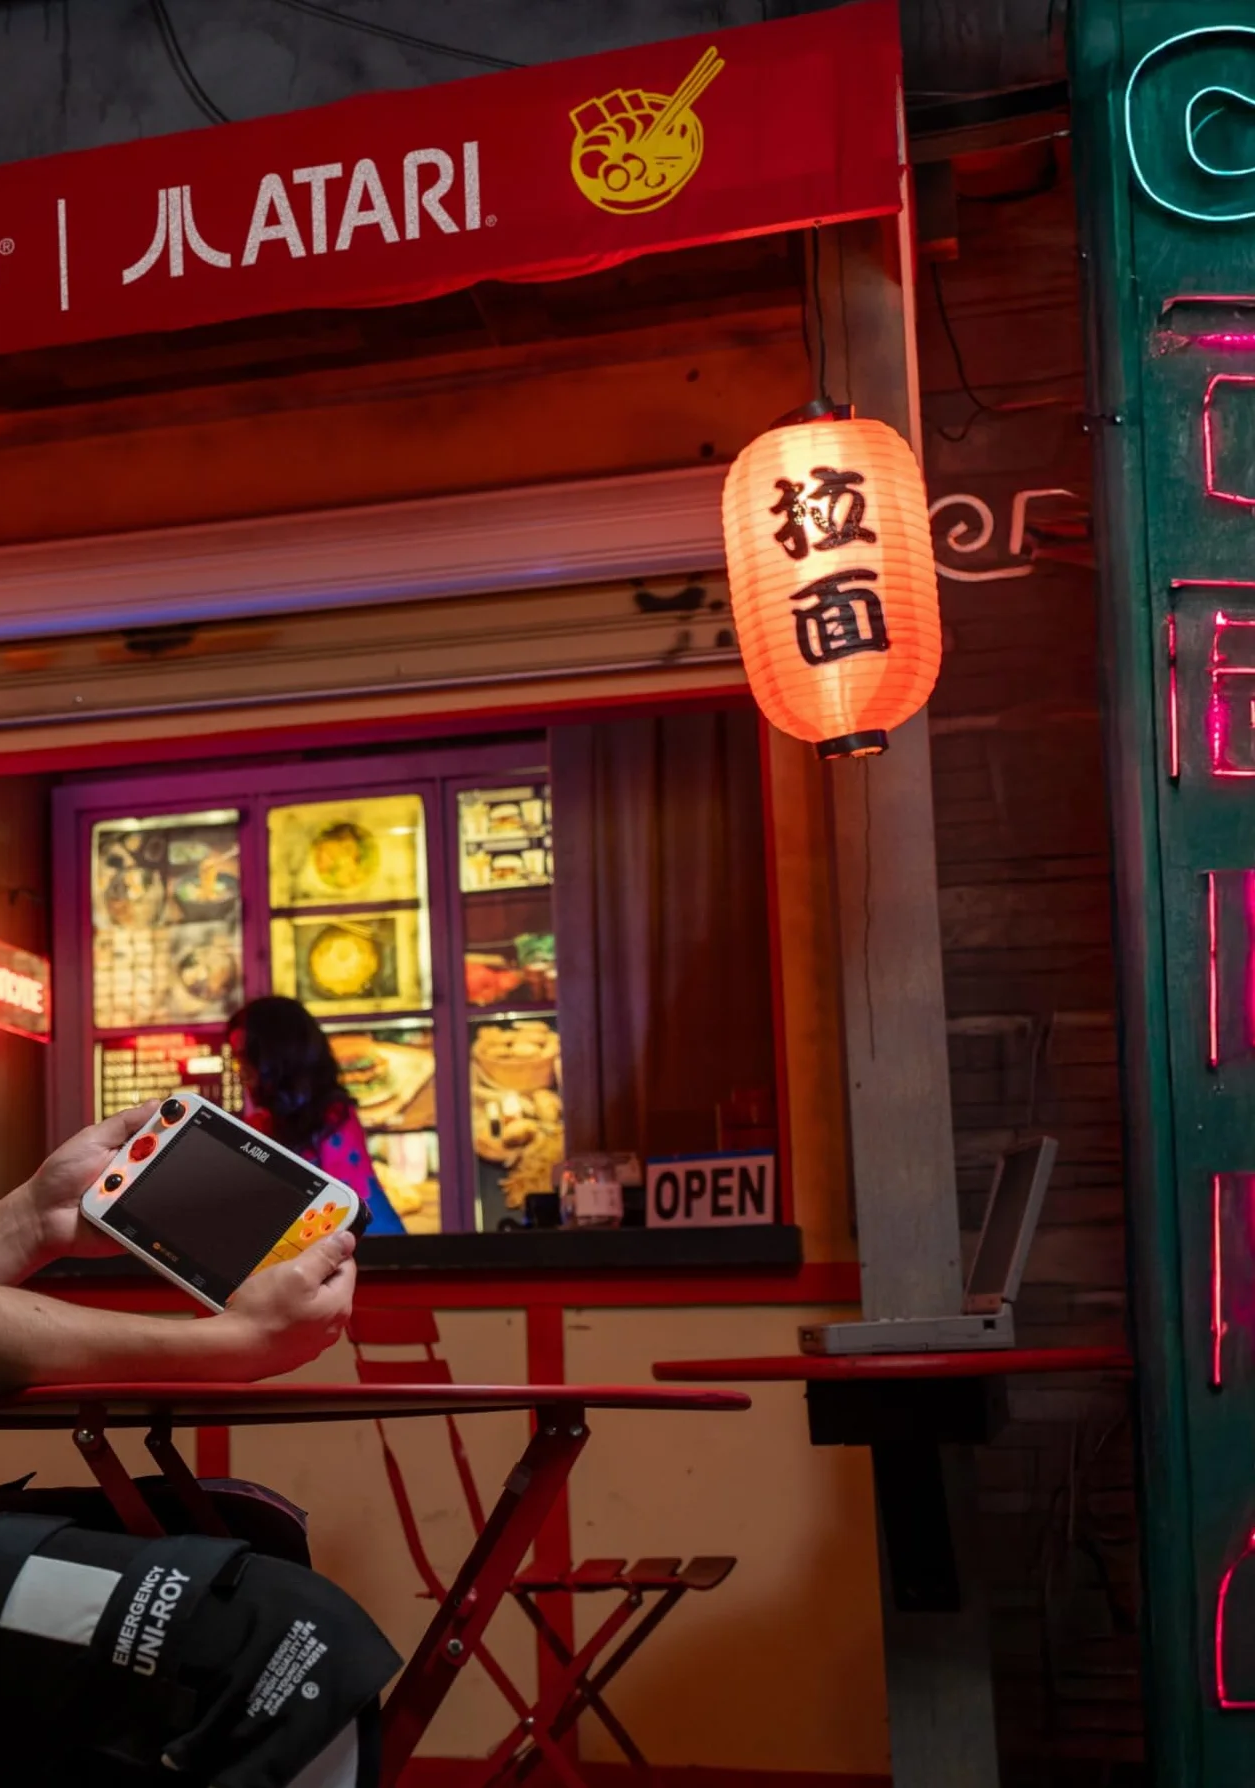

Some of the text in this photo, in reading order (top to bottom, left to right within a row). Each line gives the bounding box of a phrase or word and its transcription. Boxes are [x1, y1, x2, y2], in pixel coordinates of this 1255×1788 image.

[769, 466, 890, 666] 拉面
[654, 1165, 766, 1221] OPEN
[112, 1565, 165, 1667] EMERGENCY
[133, 1568, 191, 1677] UNI-ROY
[287, 1618, 305, 1640] LAB
[273, 1639, 303, 1678] QUALITY
